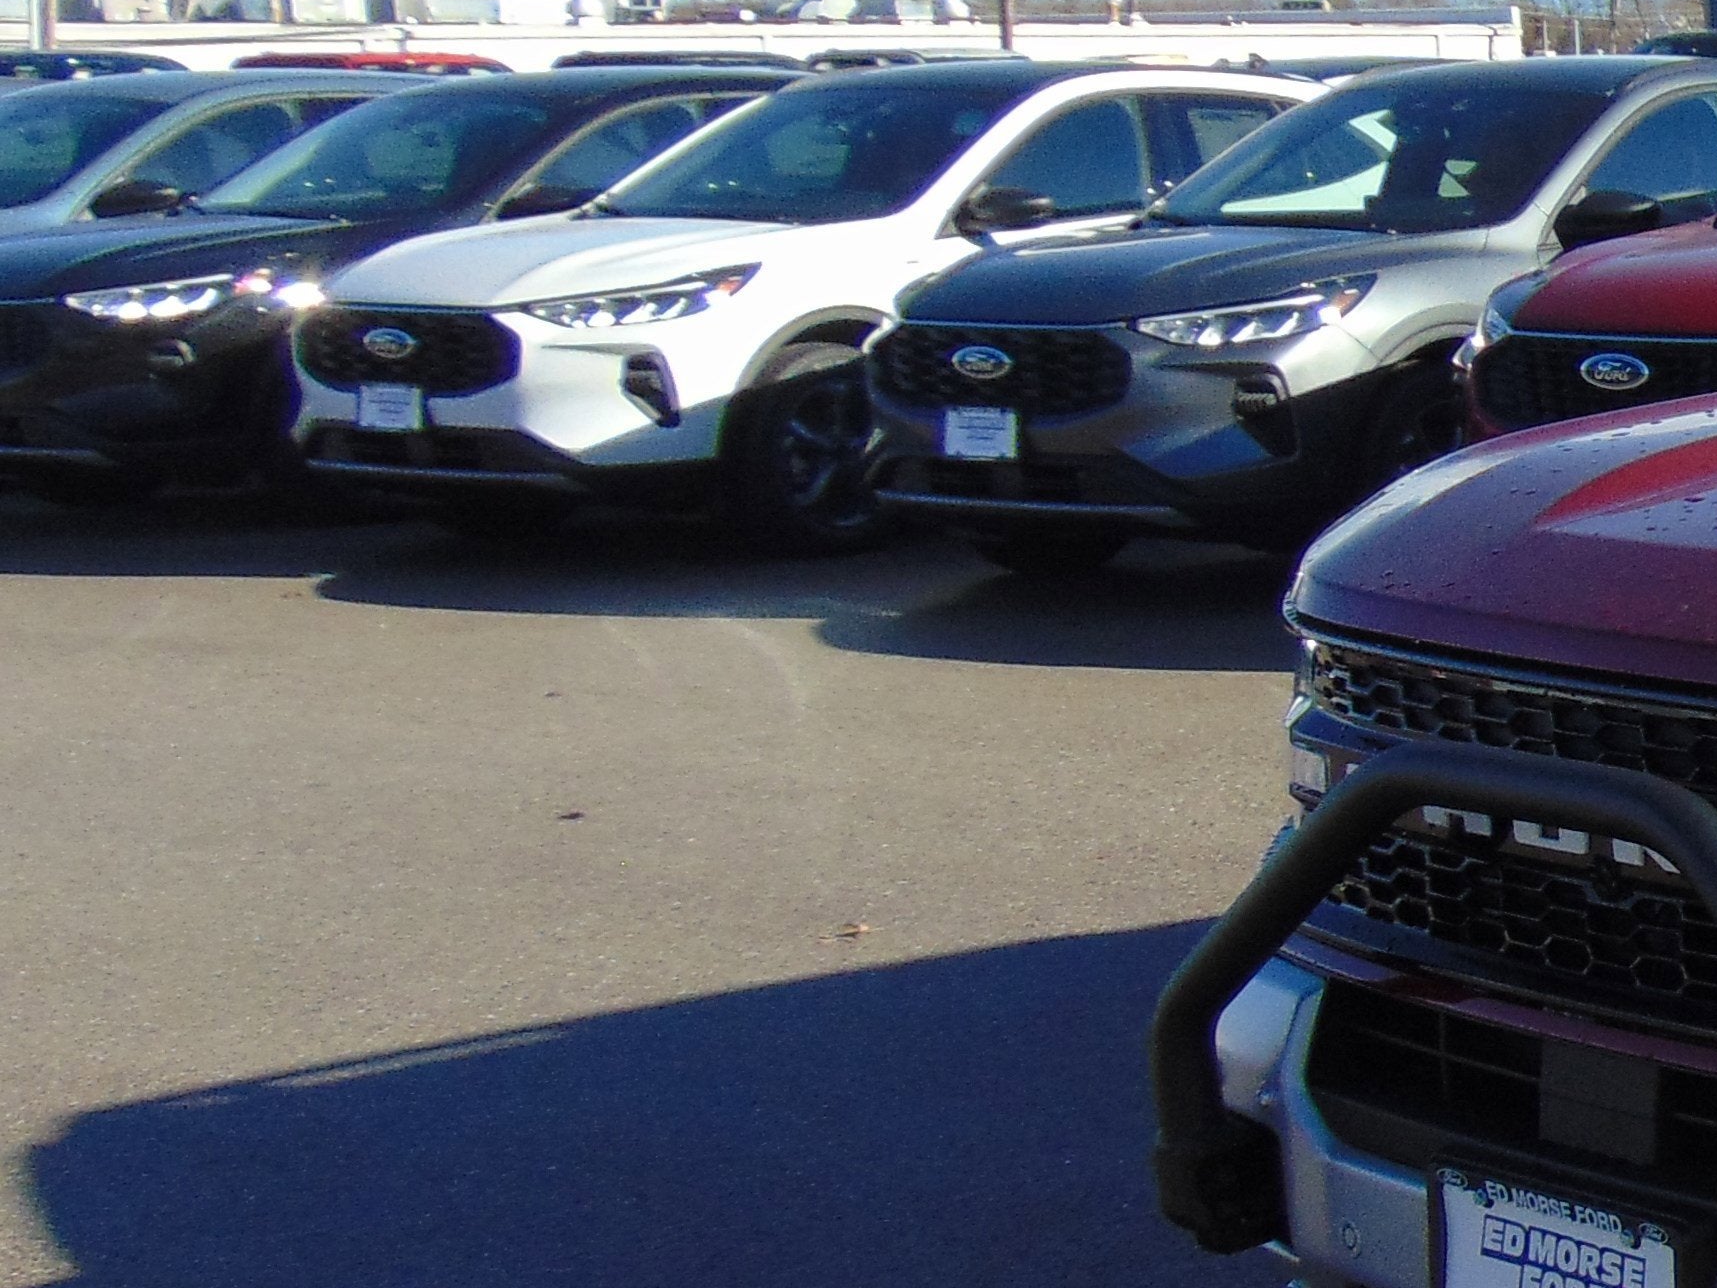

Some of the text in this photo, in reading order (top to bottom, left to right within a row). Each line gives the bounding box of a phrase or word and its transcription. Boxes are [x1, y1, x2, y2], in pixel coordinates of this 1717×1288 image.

[1486, 1180, 1623, 1234] ED MORSE FORD
[1482, 1216, 1527, 1260] ED
